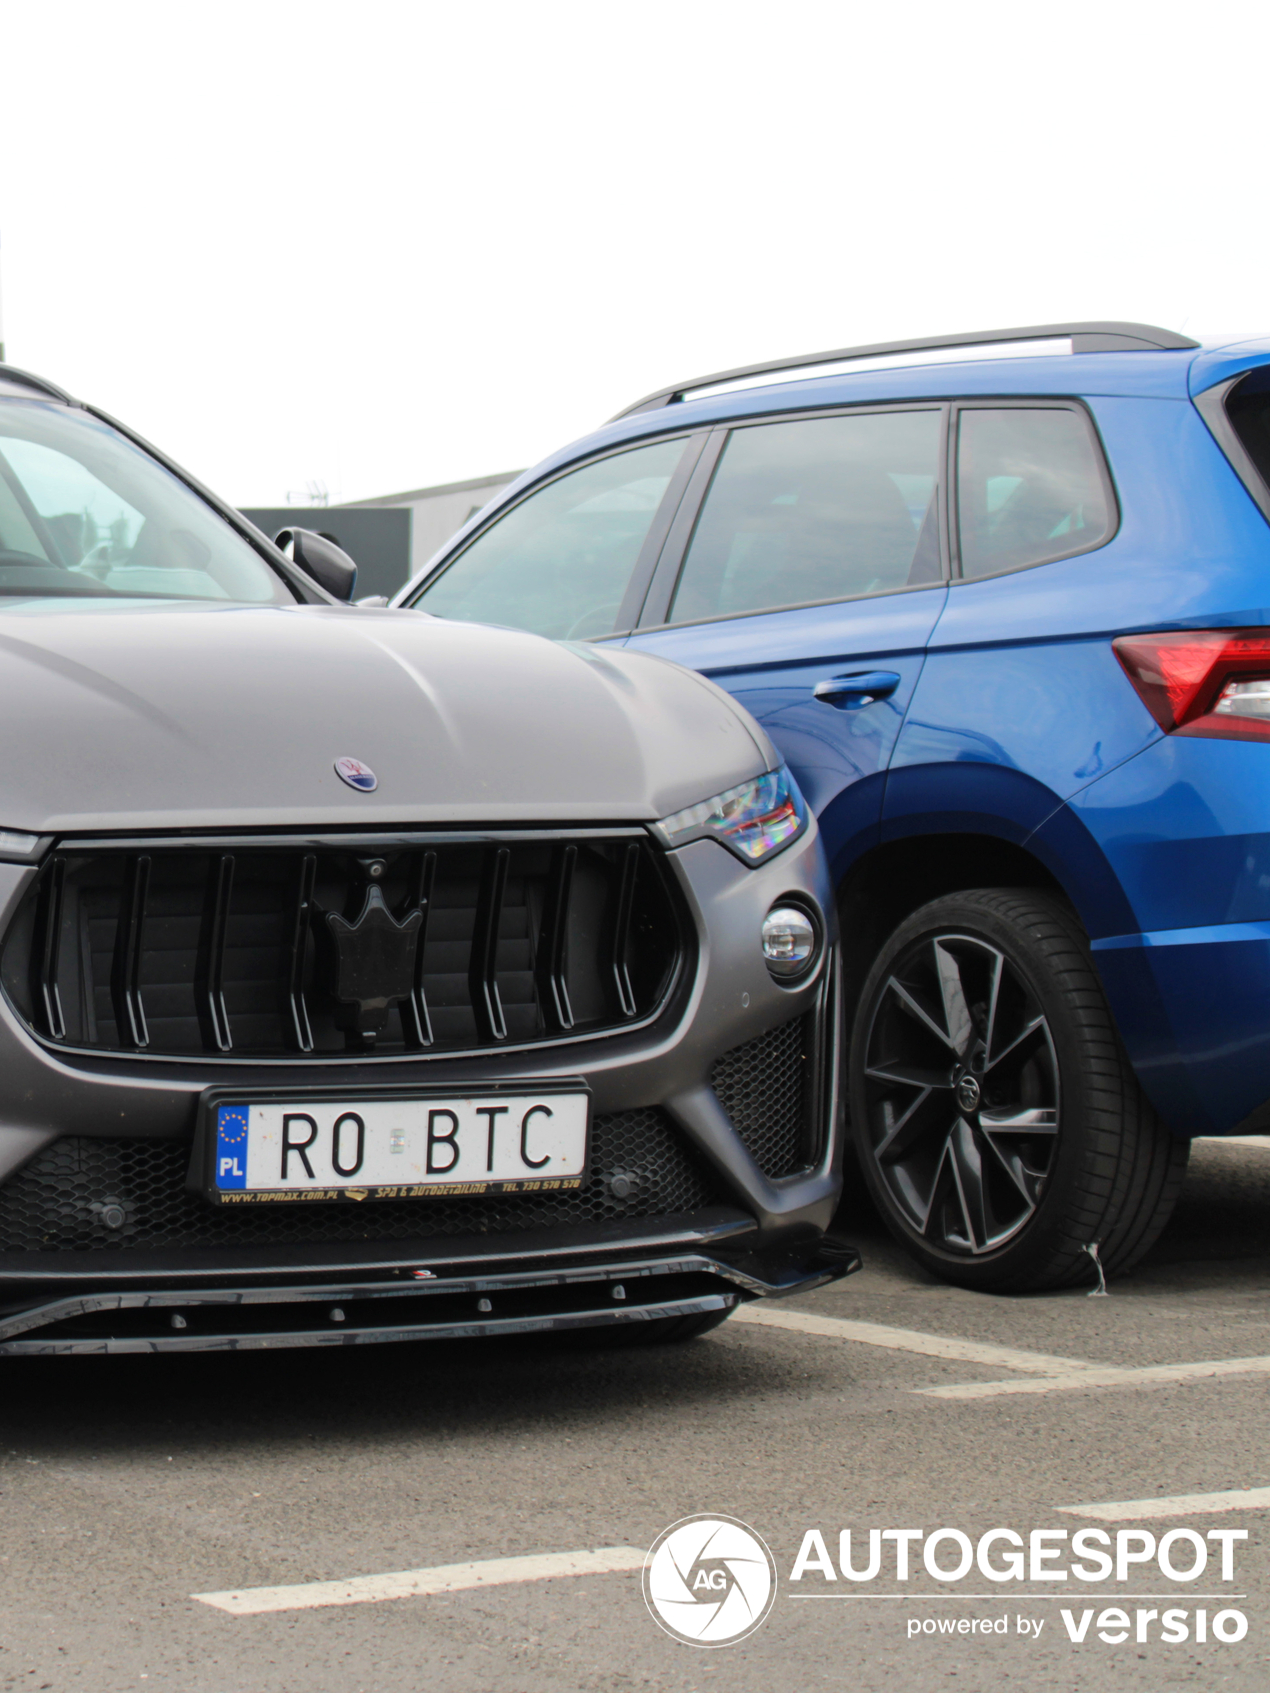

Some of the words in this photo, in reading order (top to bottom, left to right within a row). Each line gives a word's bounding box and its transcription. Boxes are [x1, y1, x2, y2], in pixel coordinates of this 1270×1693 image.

[426, 1104, 554, 1175] BTC
[219, 1157, 243, 1176] PL
[375, 1187, 398, 1197] SPA
[502, 1183, 519, 1192] TEL.
[523, 1181, 541, 1191] 730
